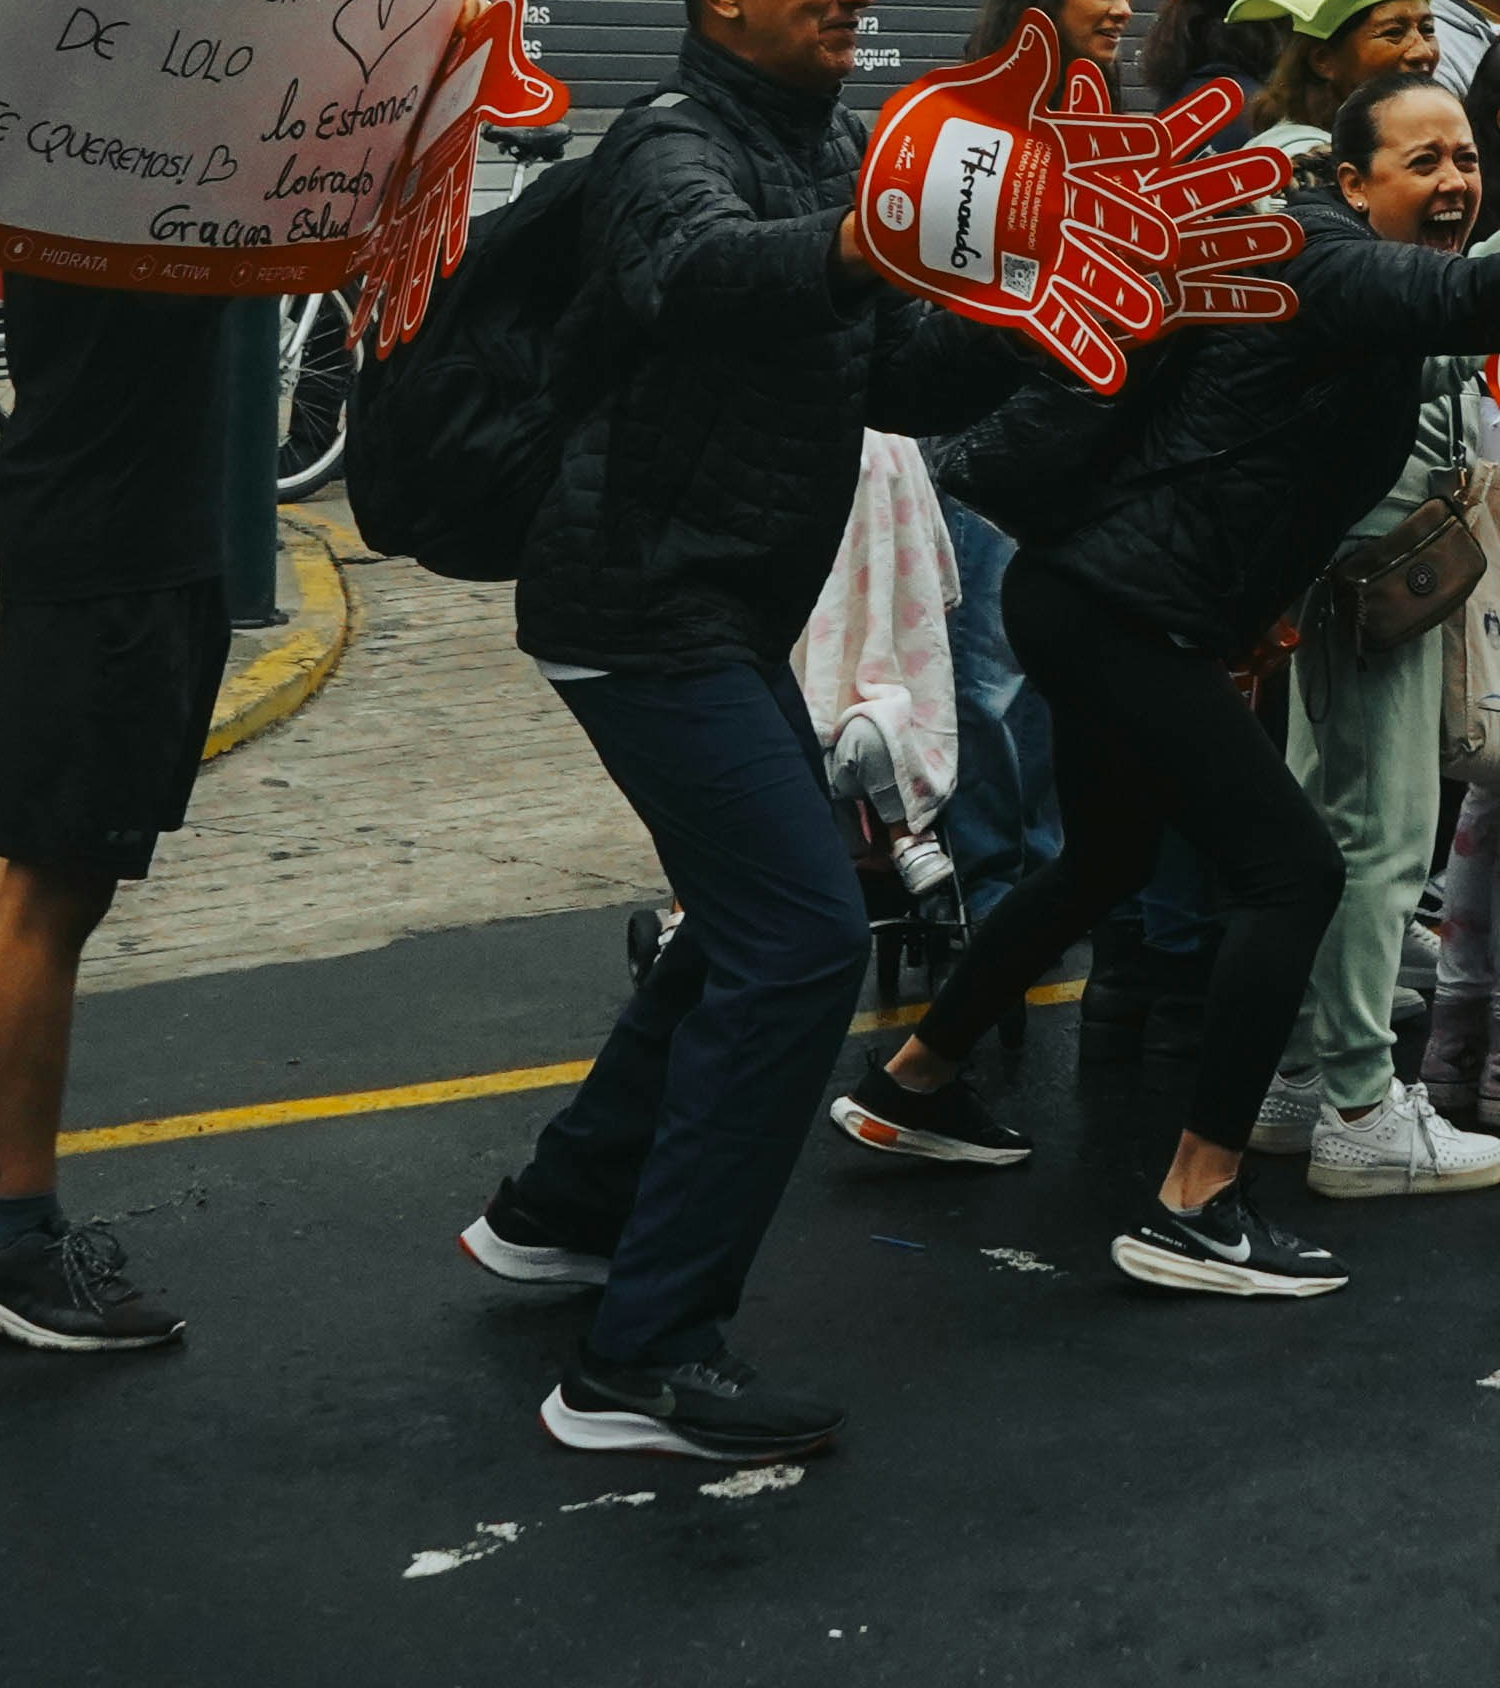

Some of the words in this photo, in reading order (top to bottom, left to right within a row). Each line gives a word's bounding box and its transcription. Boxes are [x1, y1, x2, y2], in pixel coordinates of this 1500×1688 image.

[55, 7, 131, 61] DE
[160, 29, 254, 83] LOLO
[39, 247, 110, 272] HIDRATA
[160, 263, 212, 281] ACTIVA
[256, 265, 308, 282] REPONE
